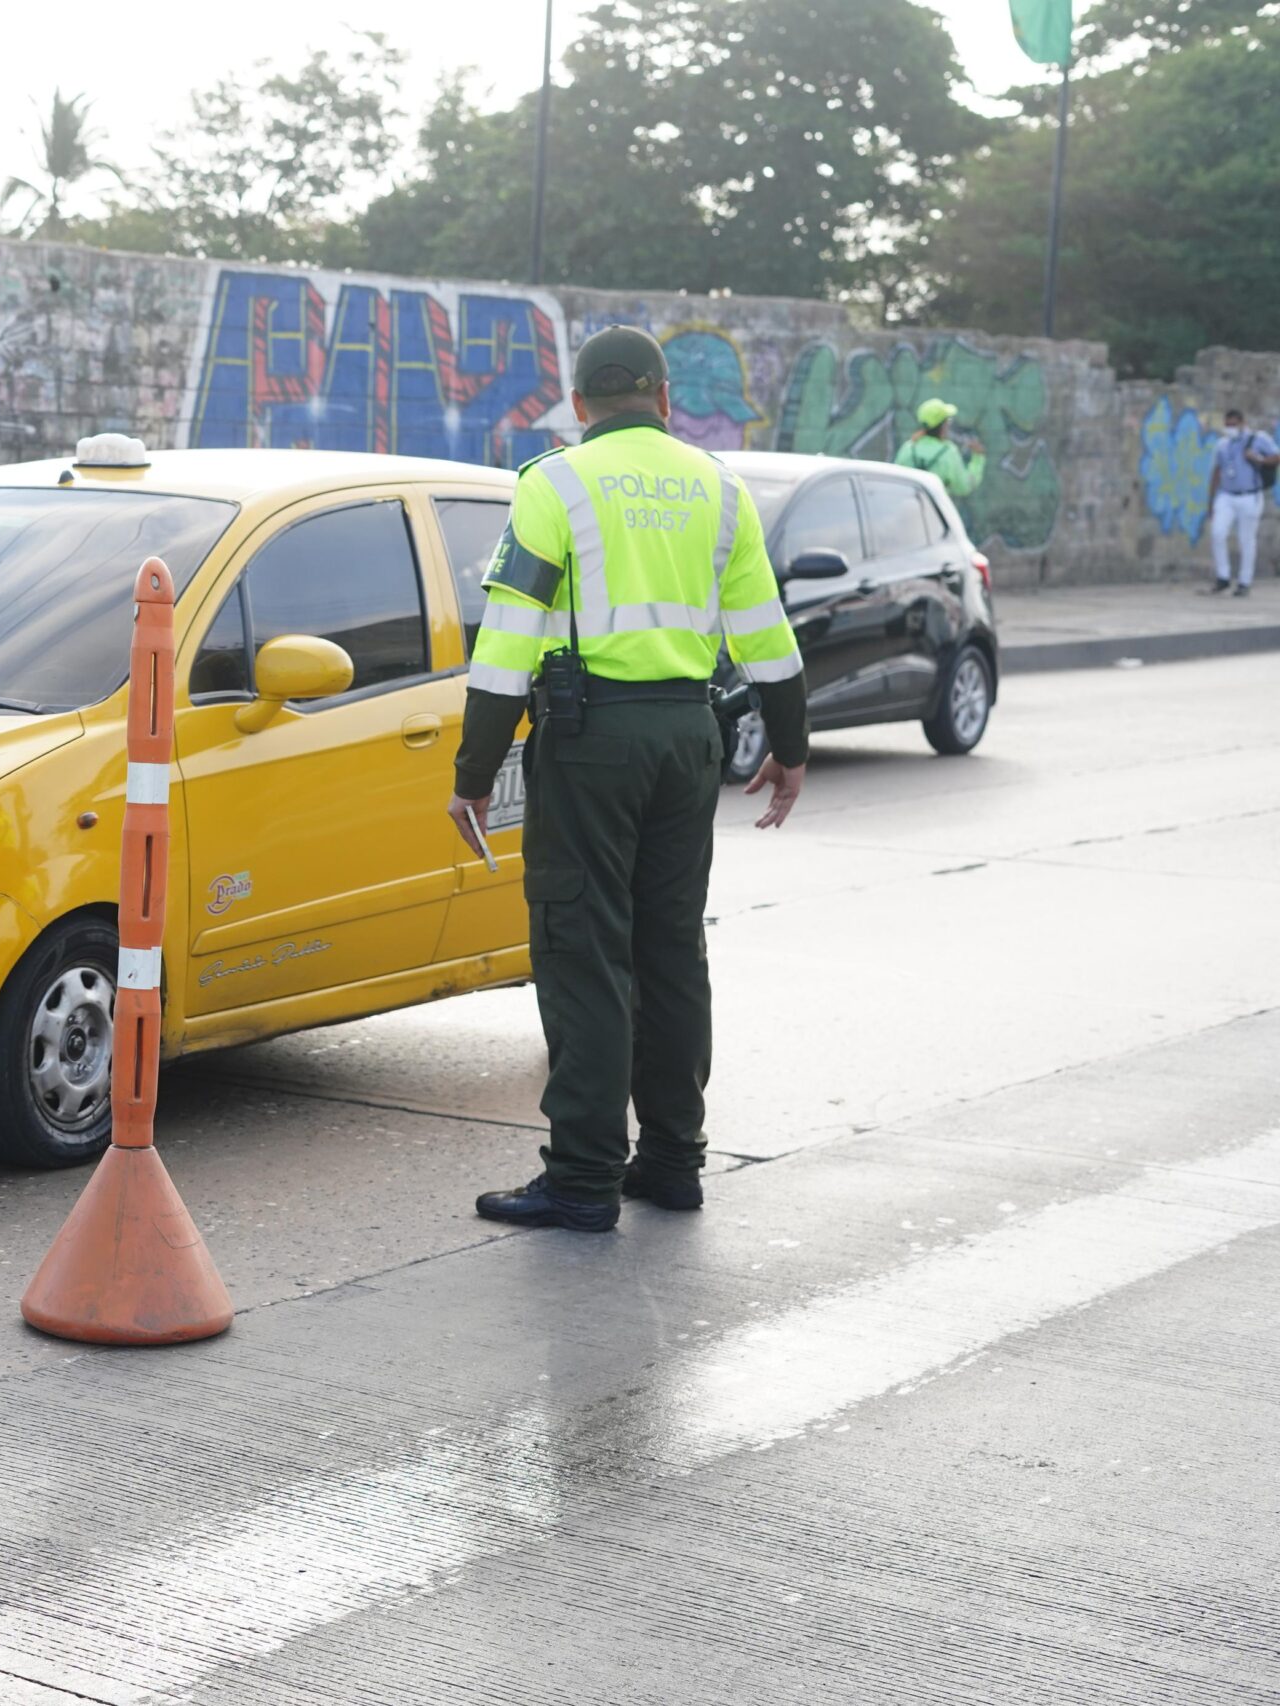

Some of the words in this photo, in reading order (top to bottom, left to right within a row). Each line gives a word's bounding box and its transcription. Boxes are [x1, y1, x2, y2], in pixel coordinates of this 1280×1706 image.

[598, 474, 710, 503] POLICIA
[624, 508, 692, 533] 93057
[213, 880, 252, 906] Prado
